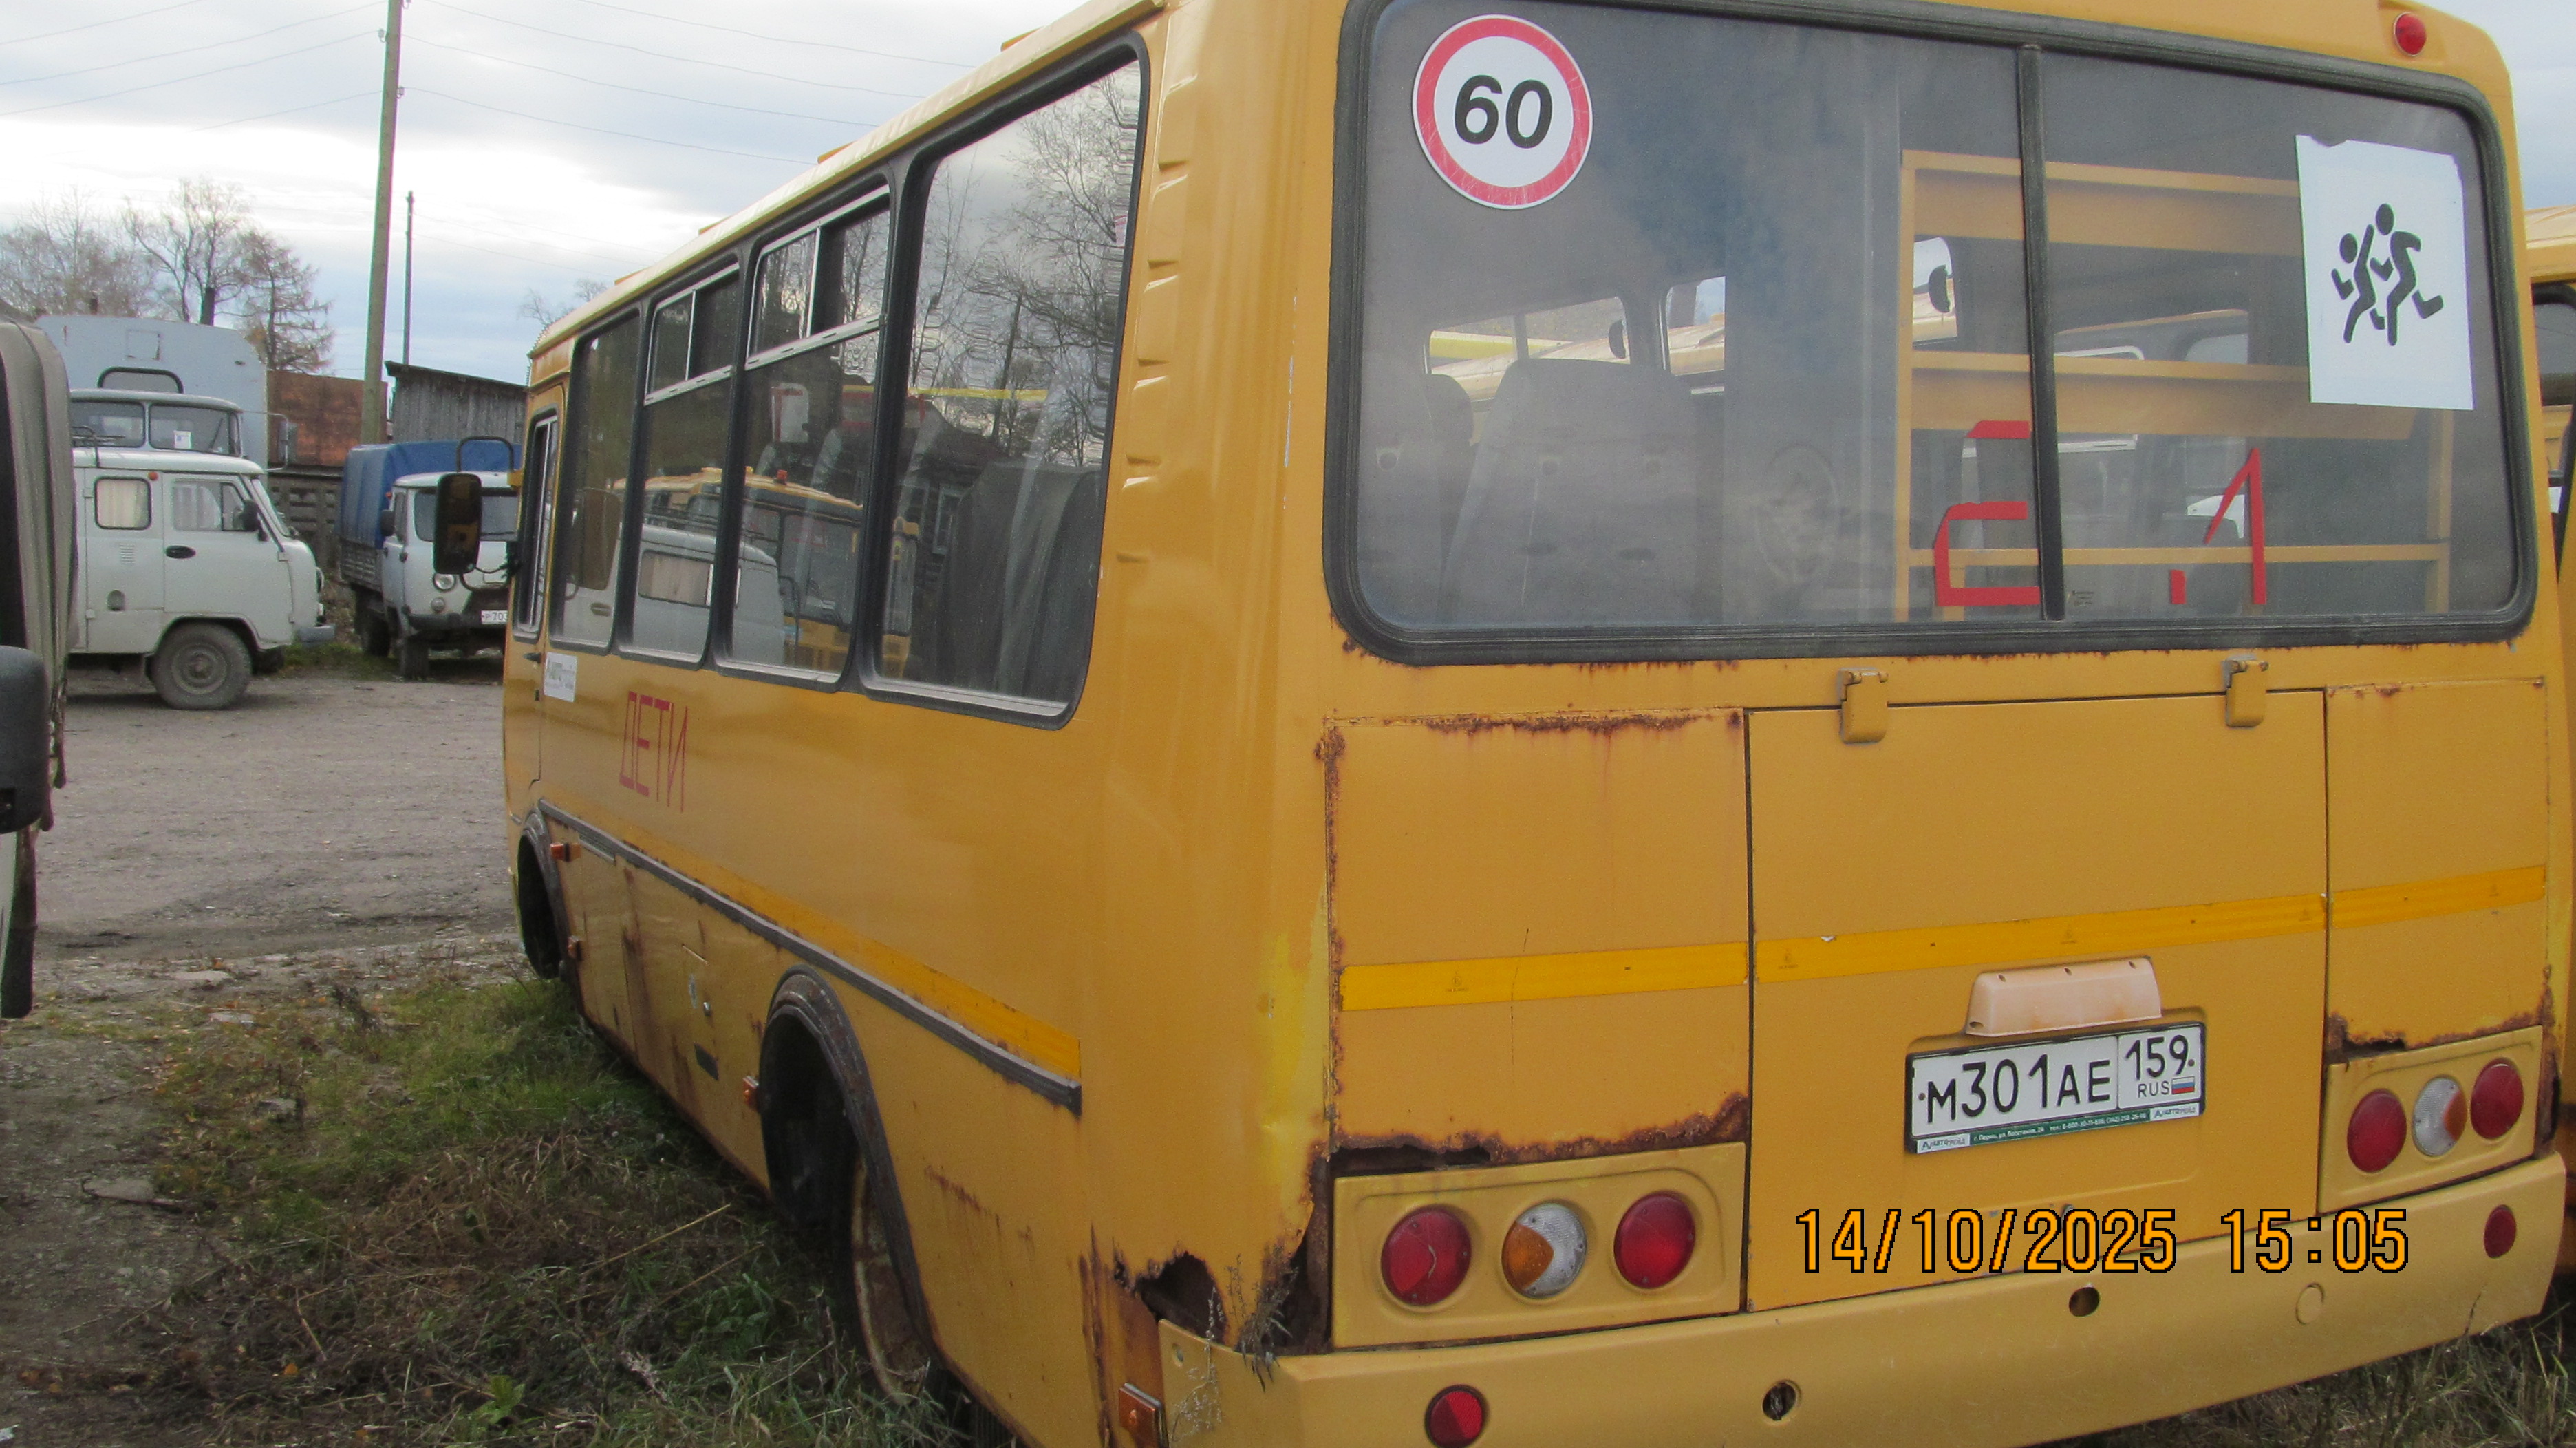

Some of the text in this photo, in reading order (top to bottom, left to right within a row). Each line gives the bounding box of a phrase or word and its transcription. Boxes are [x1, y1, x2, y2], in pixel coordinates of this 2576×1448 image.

[1454, 74, 1553, 149] 60
[619, 690, 688, 813] ДЕТИ
[2124, 1034, 2189, 1081] 159
[2137, 1080, 2170, 1098] RUS
